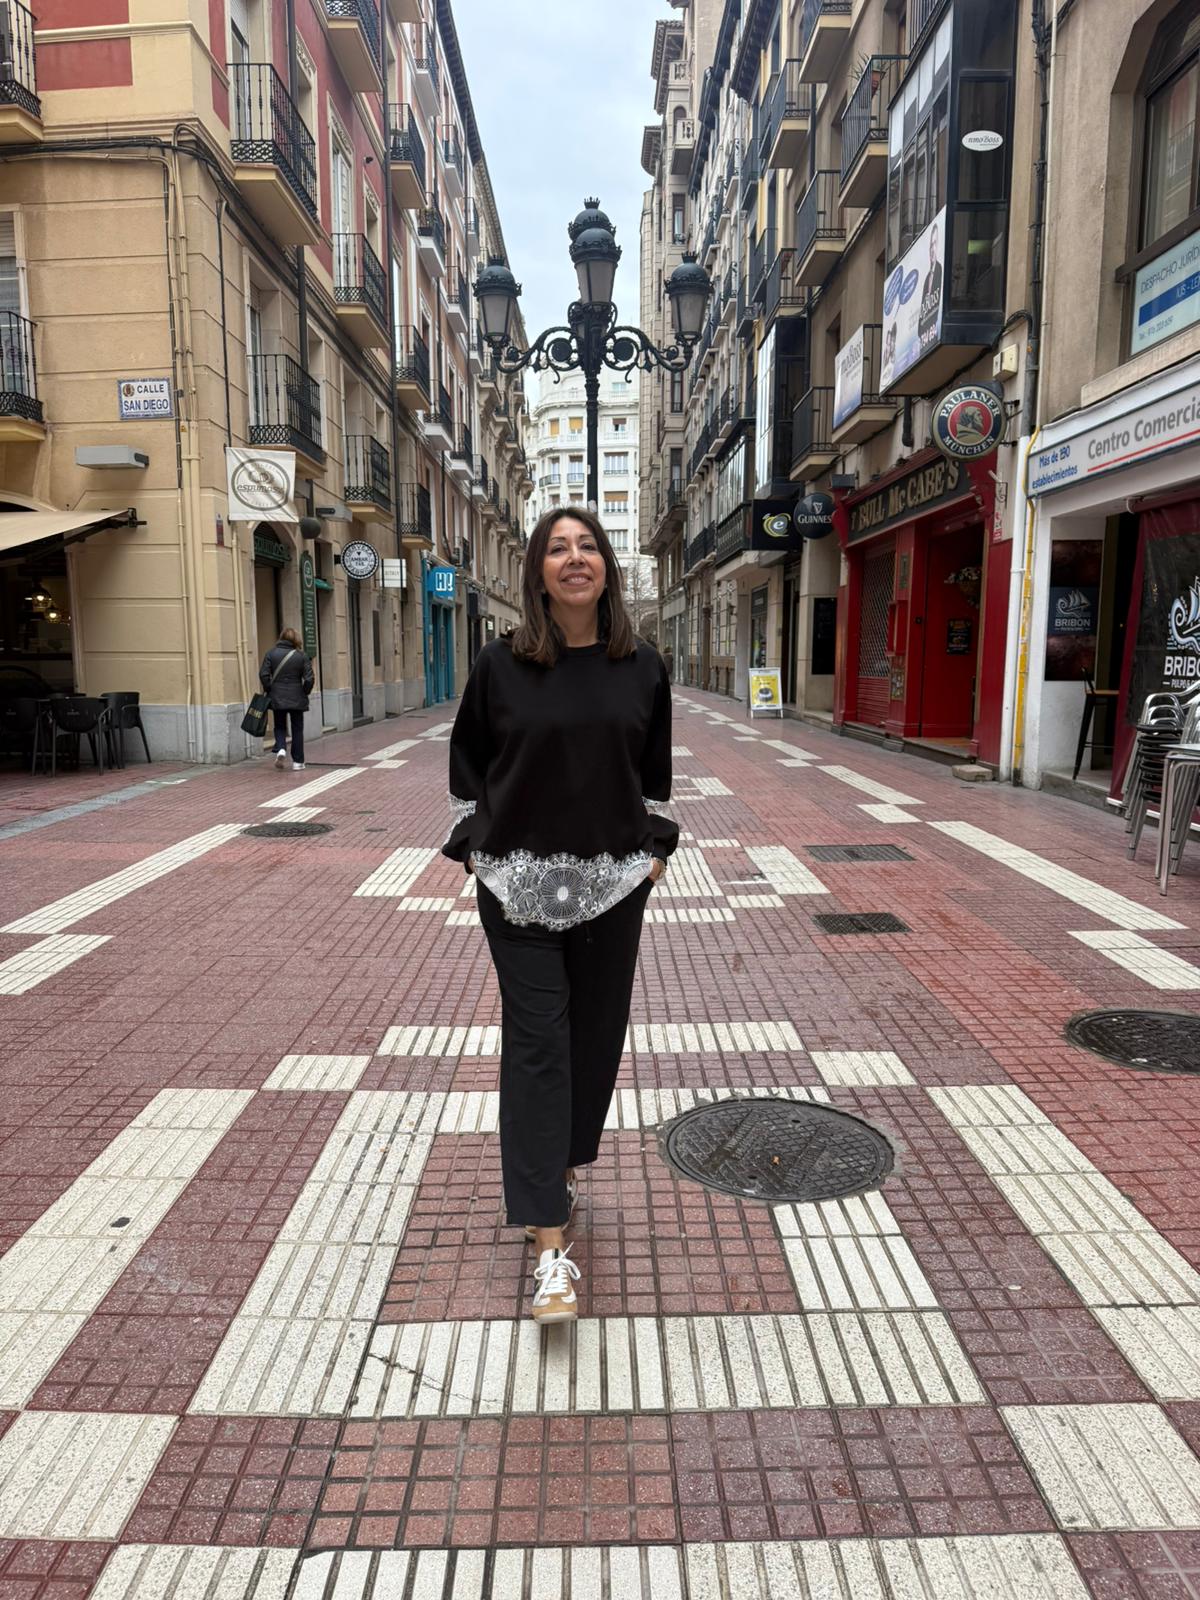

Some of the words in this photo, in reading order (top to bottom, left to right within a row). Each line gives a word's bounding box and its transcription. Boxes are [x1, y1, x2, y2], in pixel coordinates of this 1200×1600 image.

[1140, 261, 1178, 294] DESPACHO
[137, 384, 165, 394] CALLE
[123, 399, 142, 411] SAN
[143, 398, 169, 410] DIEGO
[940, 390, 1001, 417] PAULANER
[1088, 430, 1130, 460] Centro
[1039, 454, 1050, 469] Más
[1050, 449, 1059, 464] de
[1032, 465, 1078, 490] establecimientos
[857, 494, 885, 531] BULL
[1055, 618, 1091, 627] BRIBON
